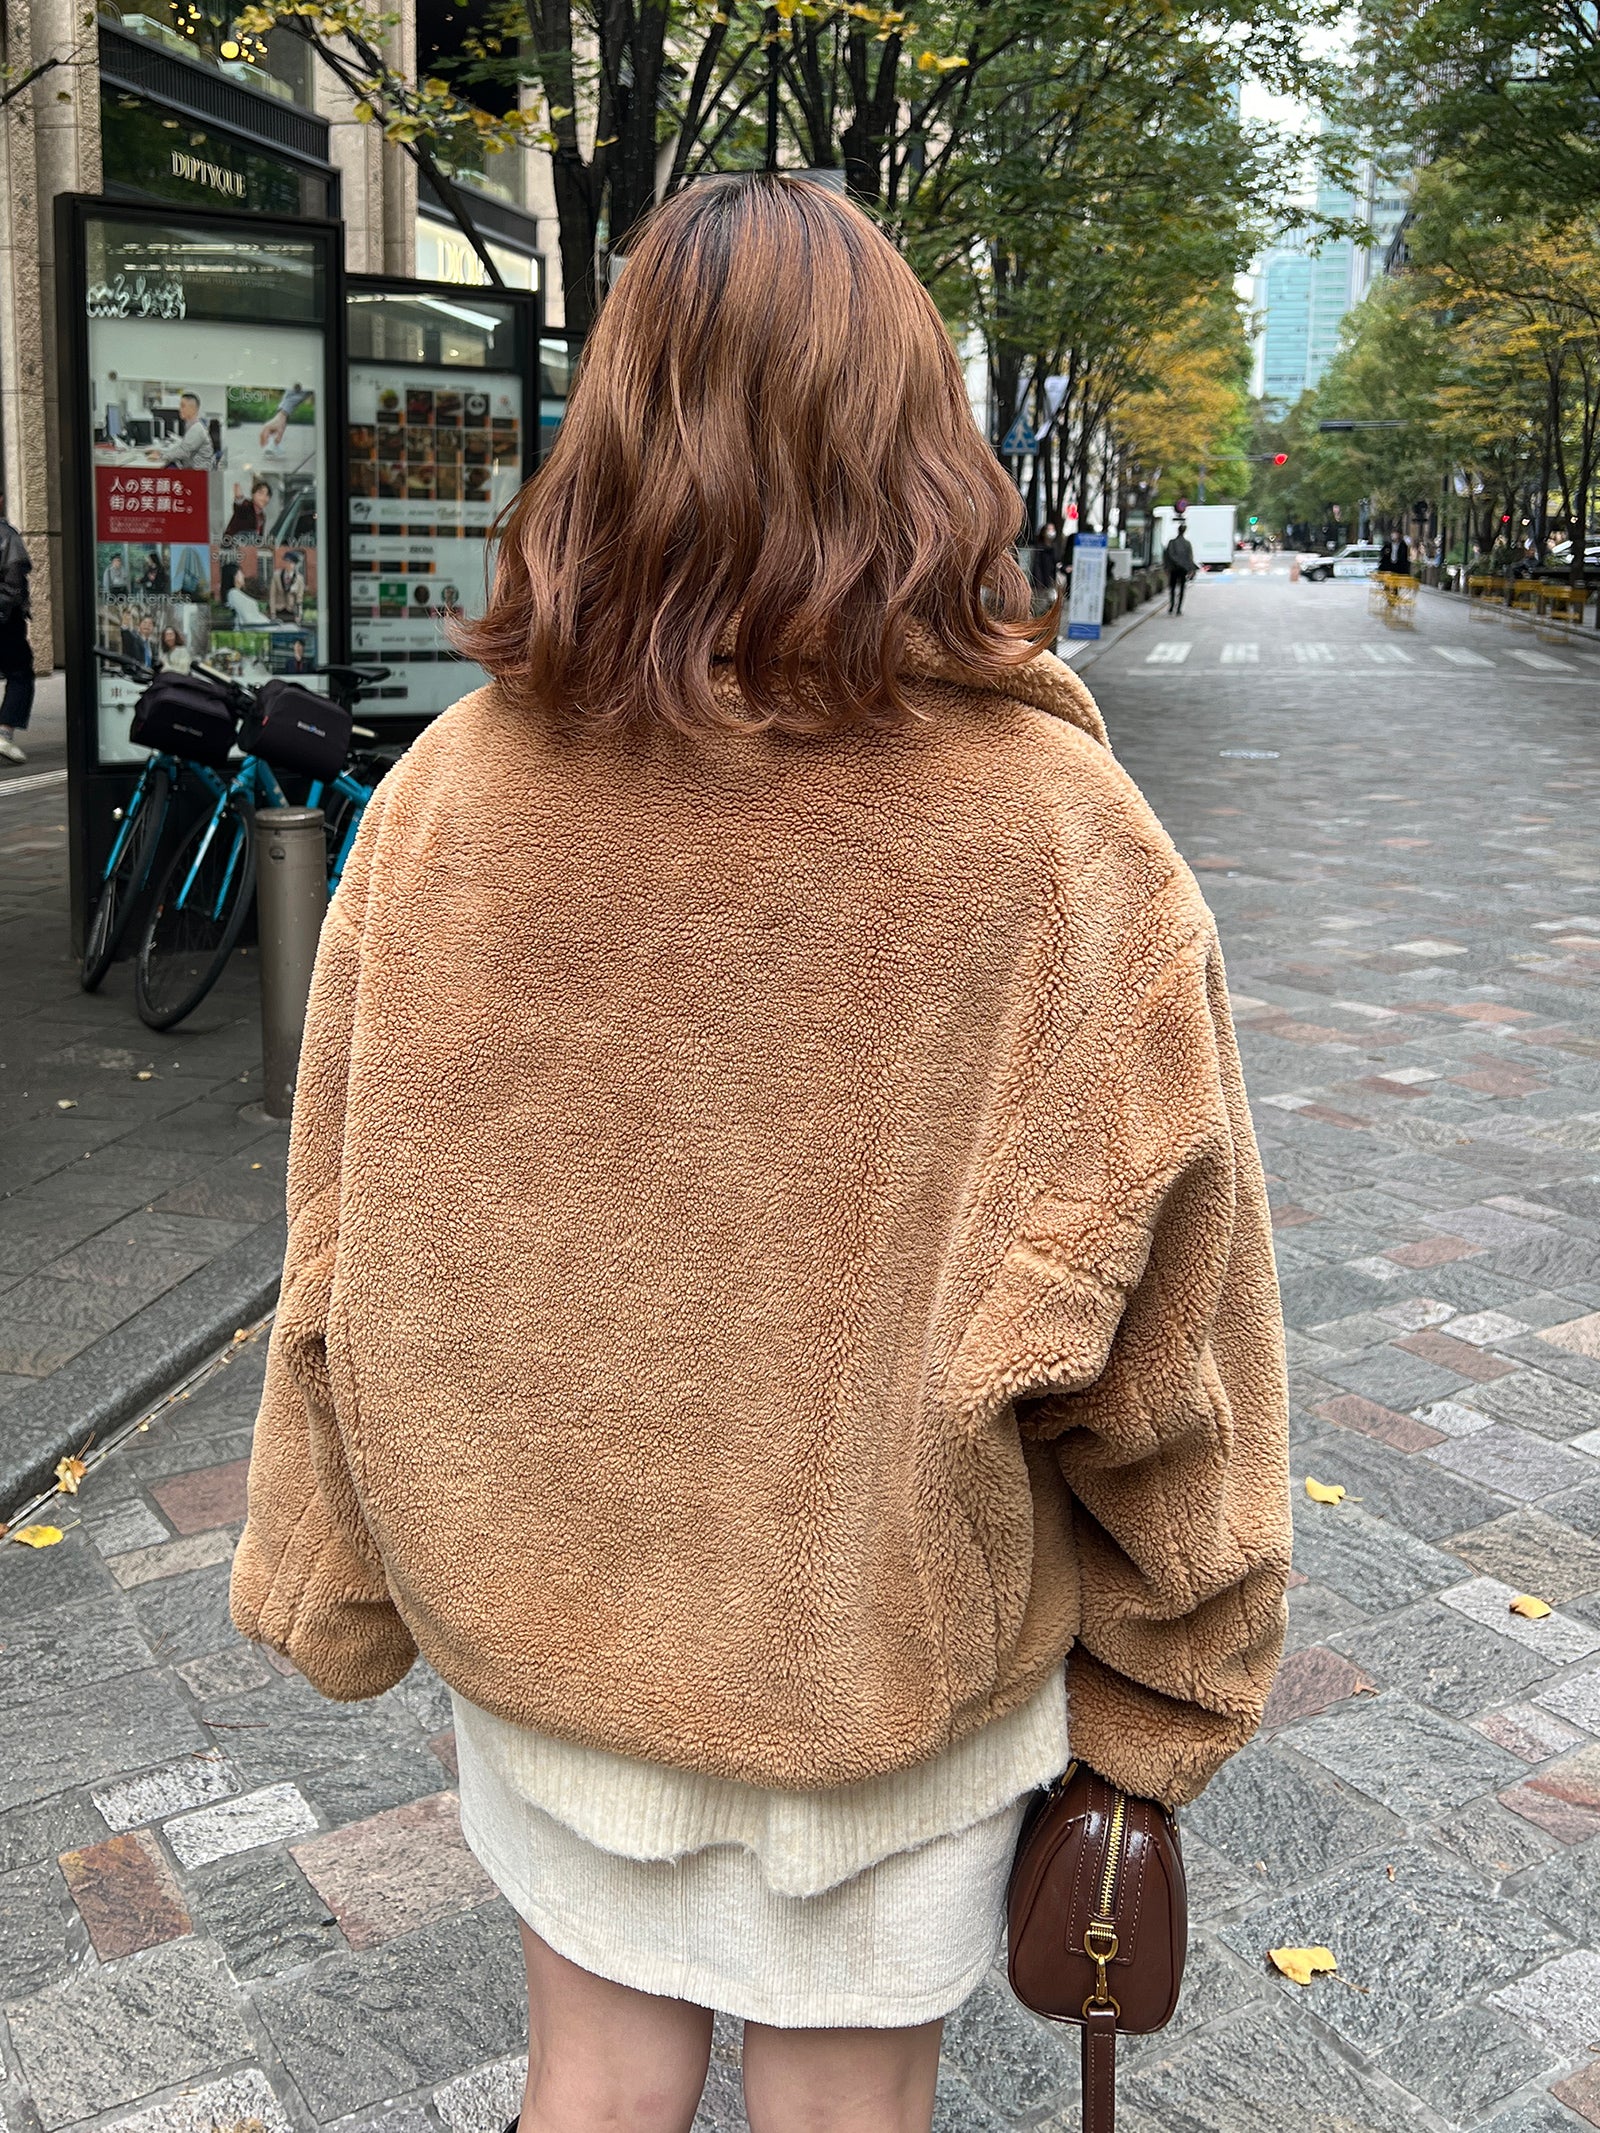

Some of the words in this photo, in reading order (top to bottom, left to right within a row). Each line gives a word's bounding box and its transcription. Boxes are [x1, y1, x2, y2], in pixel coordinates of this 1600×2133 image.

[171, 150, 247, 199] DIPTYQUE
[110, 476, 192, 496] 人の笑顔を、
[109, 494, 194, 515] 街の笑顔に。
